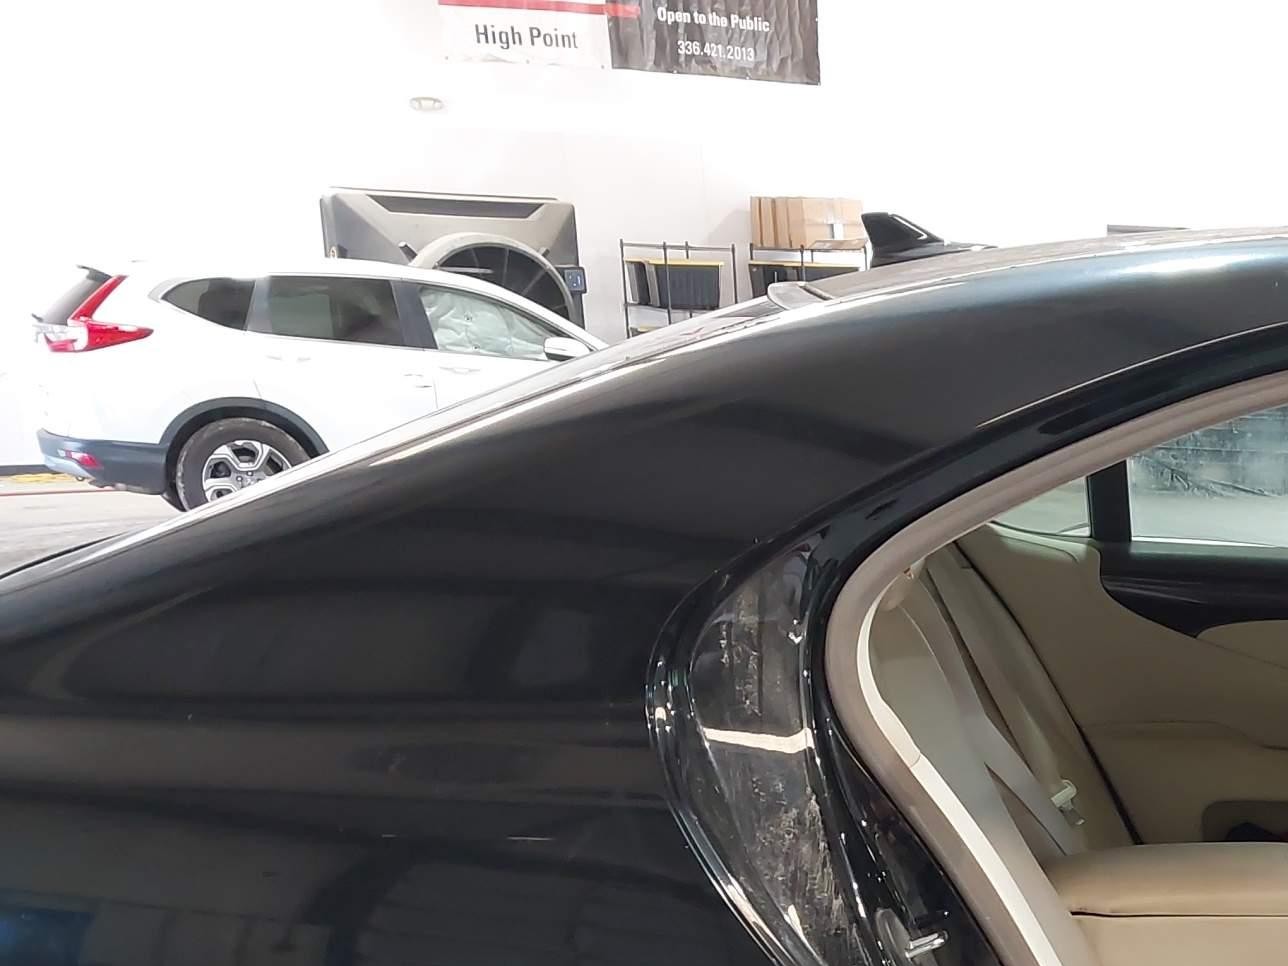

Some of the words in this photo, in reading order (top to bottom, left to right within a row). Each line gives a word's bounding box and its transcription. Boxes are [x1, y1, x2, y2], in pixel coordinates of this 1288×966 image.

[656, 7, 692, 25] Open
[693, 11, 707, 25] to
[707, 13, 729, 29] the
[730, 14, 770, 33] Public
[474, 23, 523, 50] High
[528, 27, 579, 49] Point
[676, 39, 755, 62] 336.421.2013
